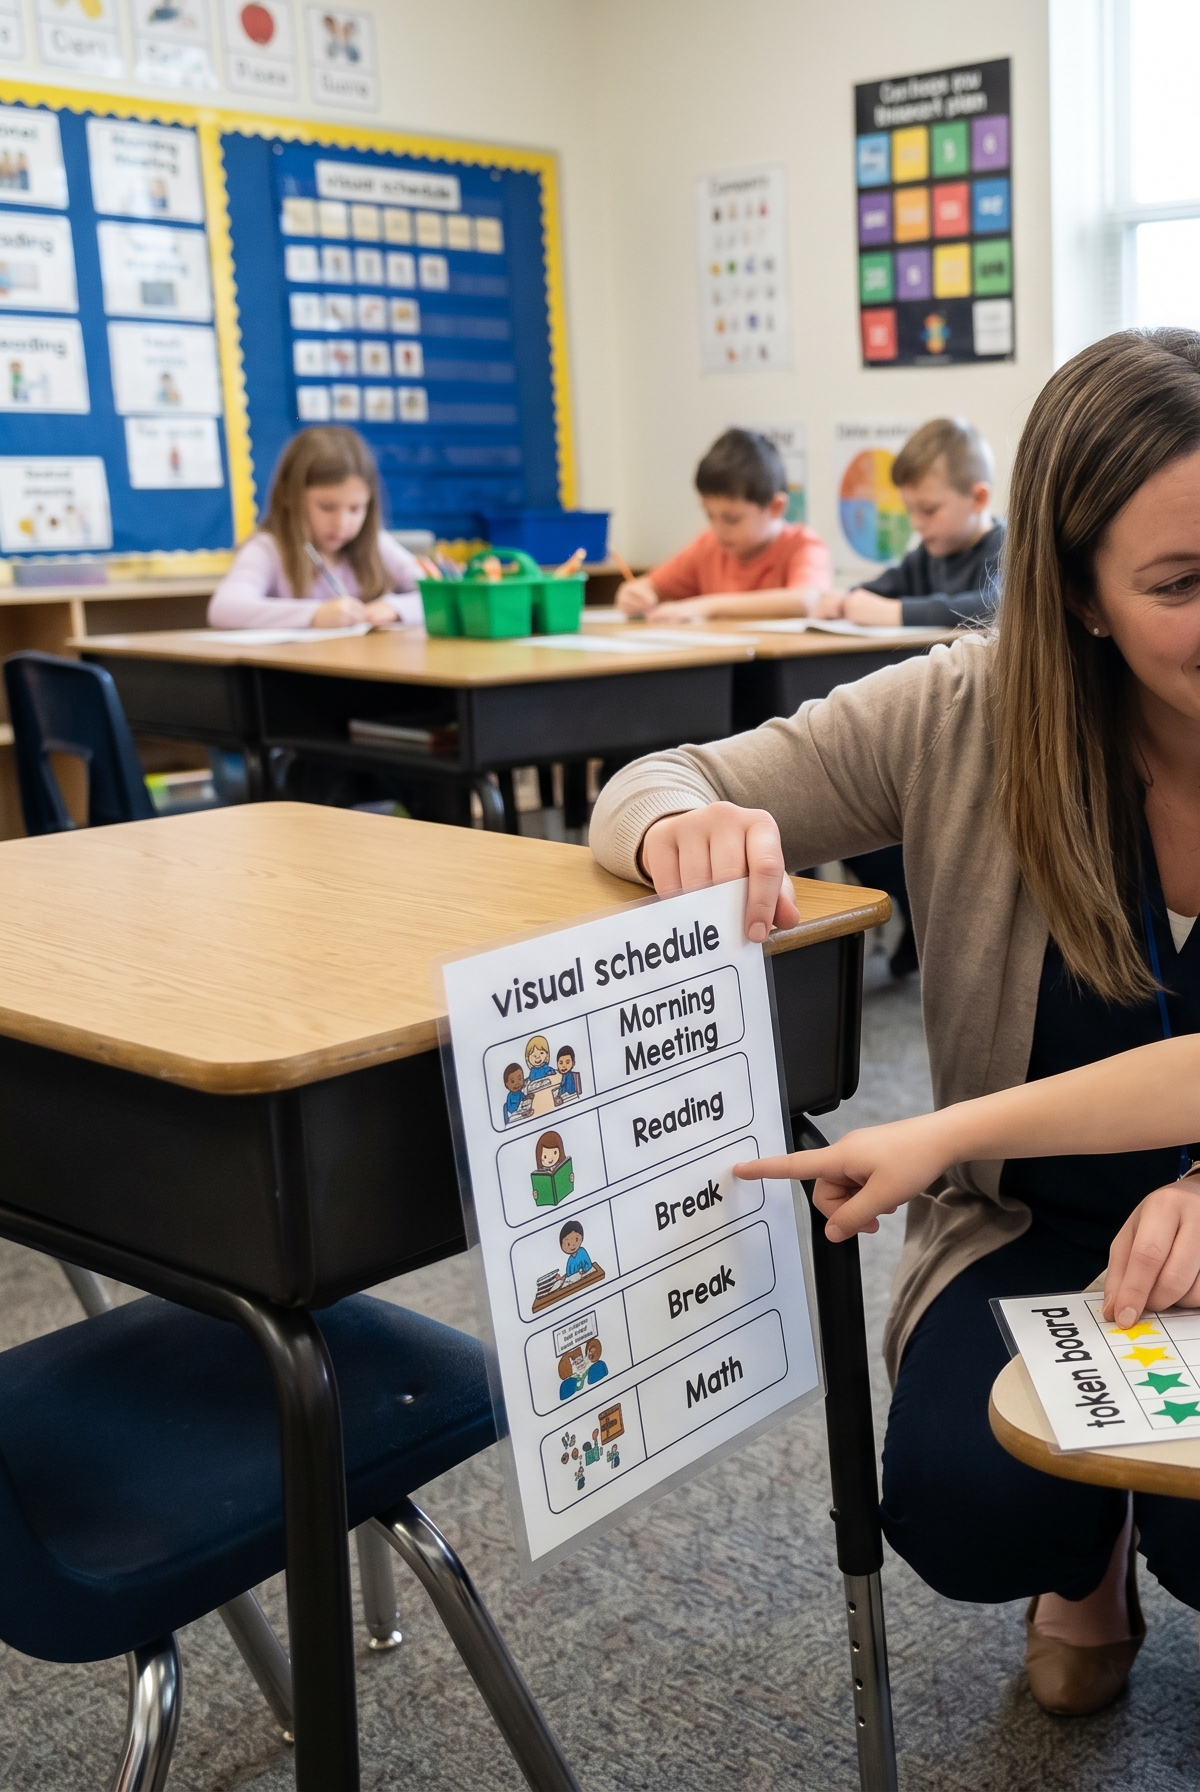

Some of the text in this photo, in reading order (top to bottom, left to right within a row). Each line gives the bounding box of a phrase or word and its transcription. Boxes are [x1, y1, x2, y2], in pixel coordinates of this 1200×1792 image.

[492, 920, 720, 1018] visual schedule
[619, 984, 716, 1037] Morning
[624, 1021, 719, 1076] Meeting
[632, 1091, 724, 1148] Reading
[655, 1179, 724, 1231] Break
[667, 1264, 736, 1320] Break
[685, 1355, 744, 1409] Math
[1030, 1306, 1126, 1428] token board
